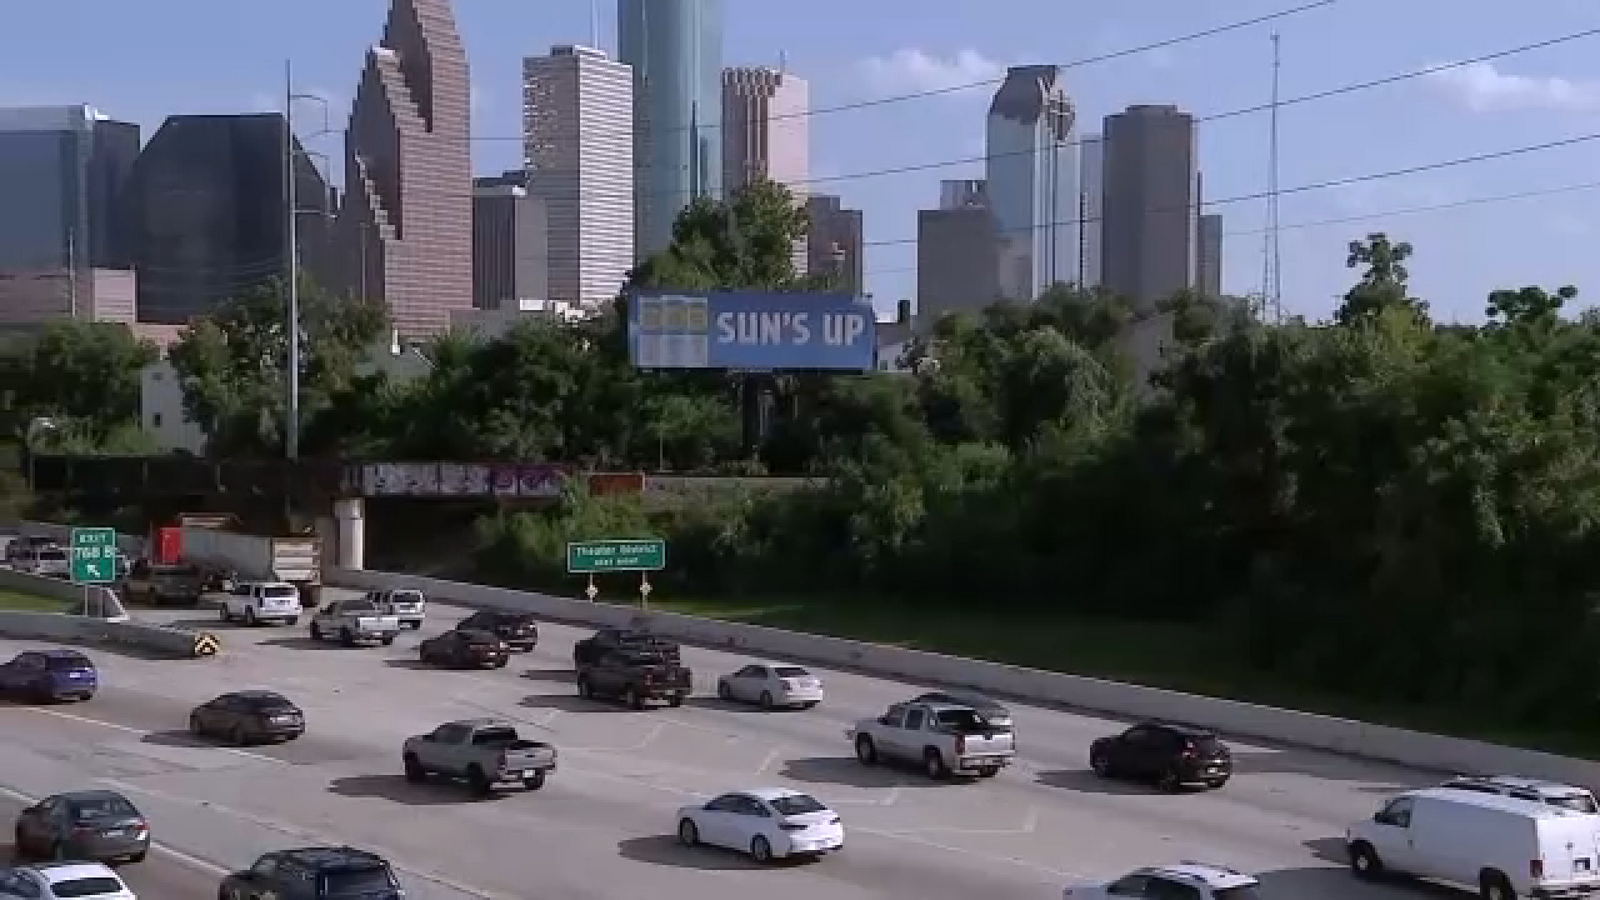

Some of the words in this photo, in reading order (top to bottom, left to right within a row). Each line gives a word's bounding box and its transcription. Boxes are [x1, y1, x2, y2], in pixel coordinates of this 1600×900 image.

[717, 312, 812, 345] SUN'S
[822, 313, 865, 345] UP
[79, 533, 106, 543] EXIT
